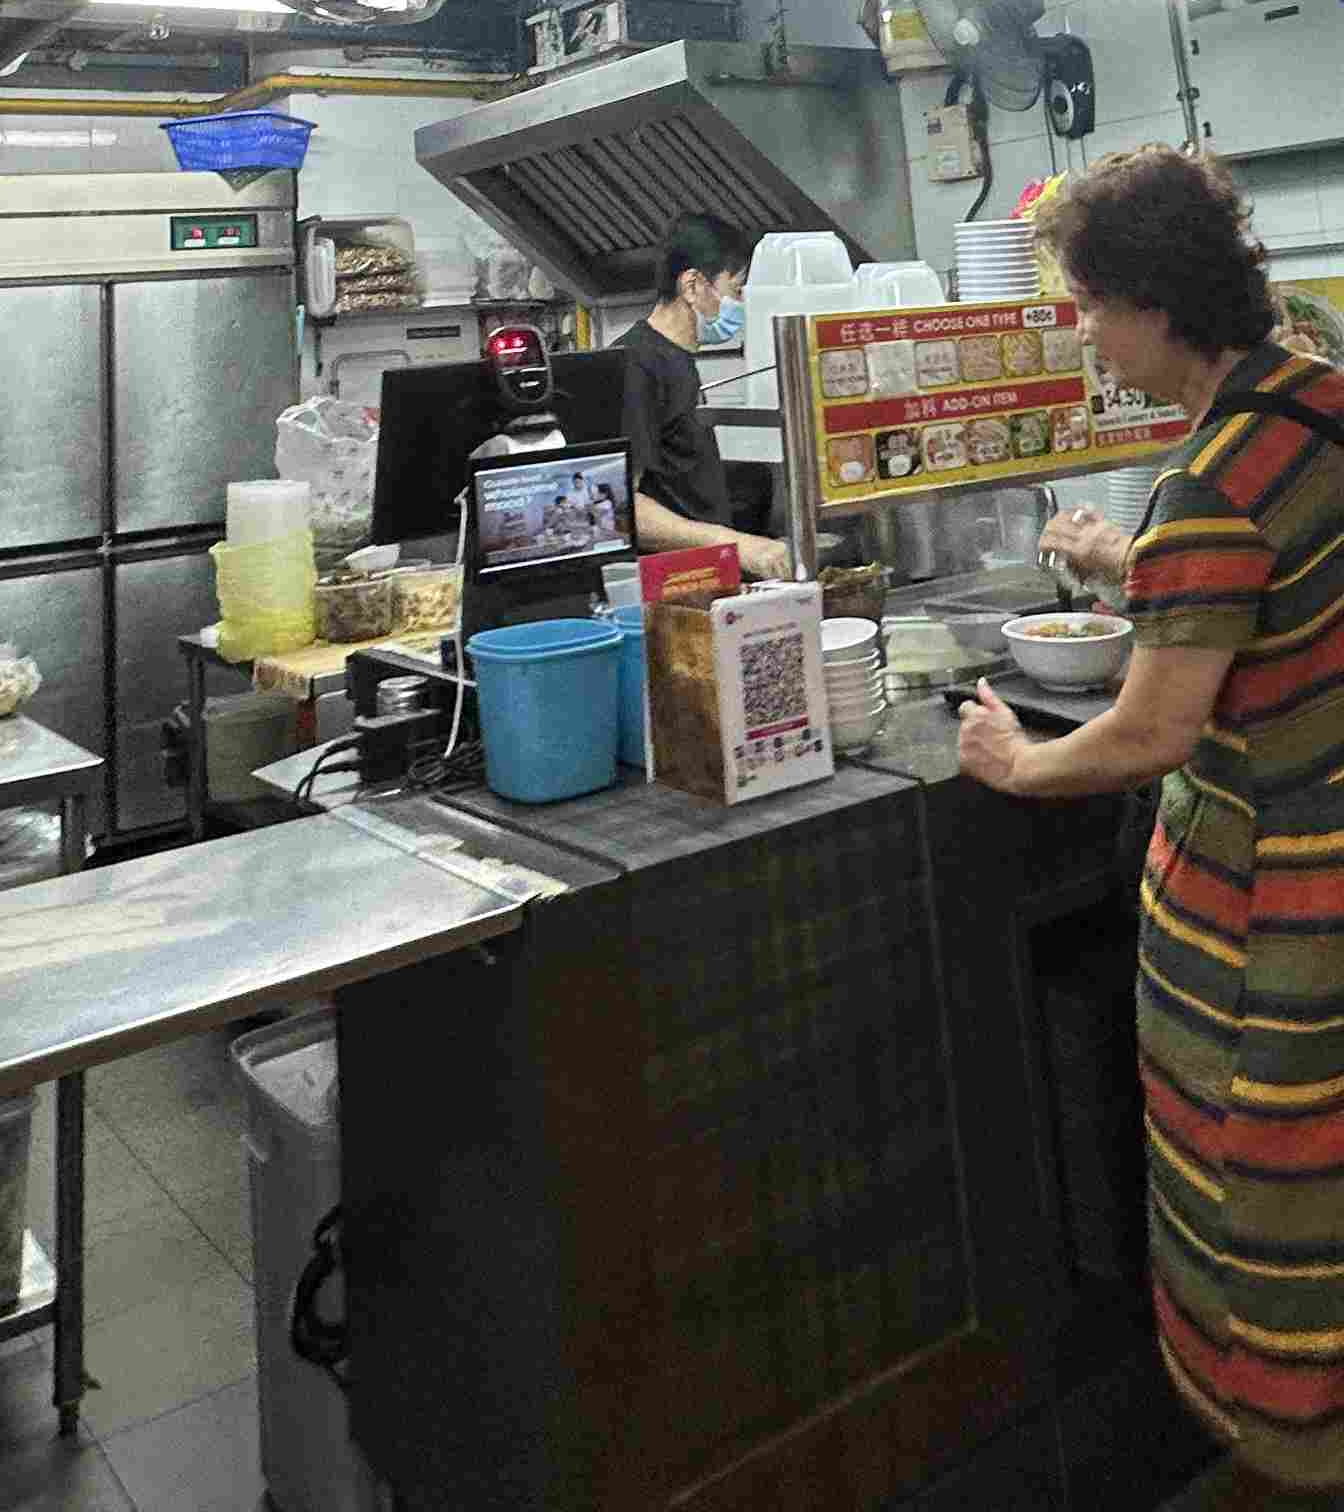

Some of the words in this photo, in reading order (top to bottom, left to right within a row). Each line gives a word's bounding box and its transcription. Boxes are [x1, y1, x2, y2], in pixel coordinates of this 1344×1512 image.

[913, 314, 965, 334] CHOOSE
[967, 313, 992, 330] ONE
[992, 311, 1018, 328] TYPE
[942, 394, 991, 414] ADD-ON
[992, 391, 1019, 408] ITEM
